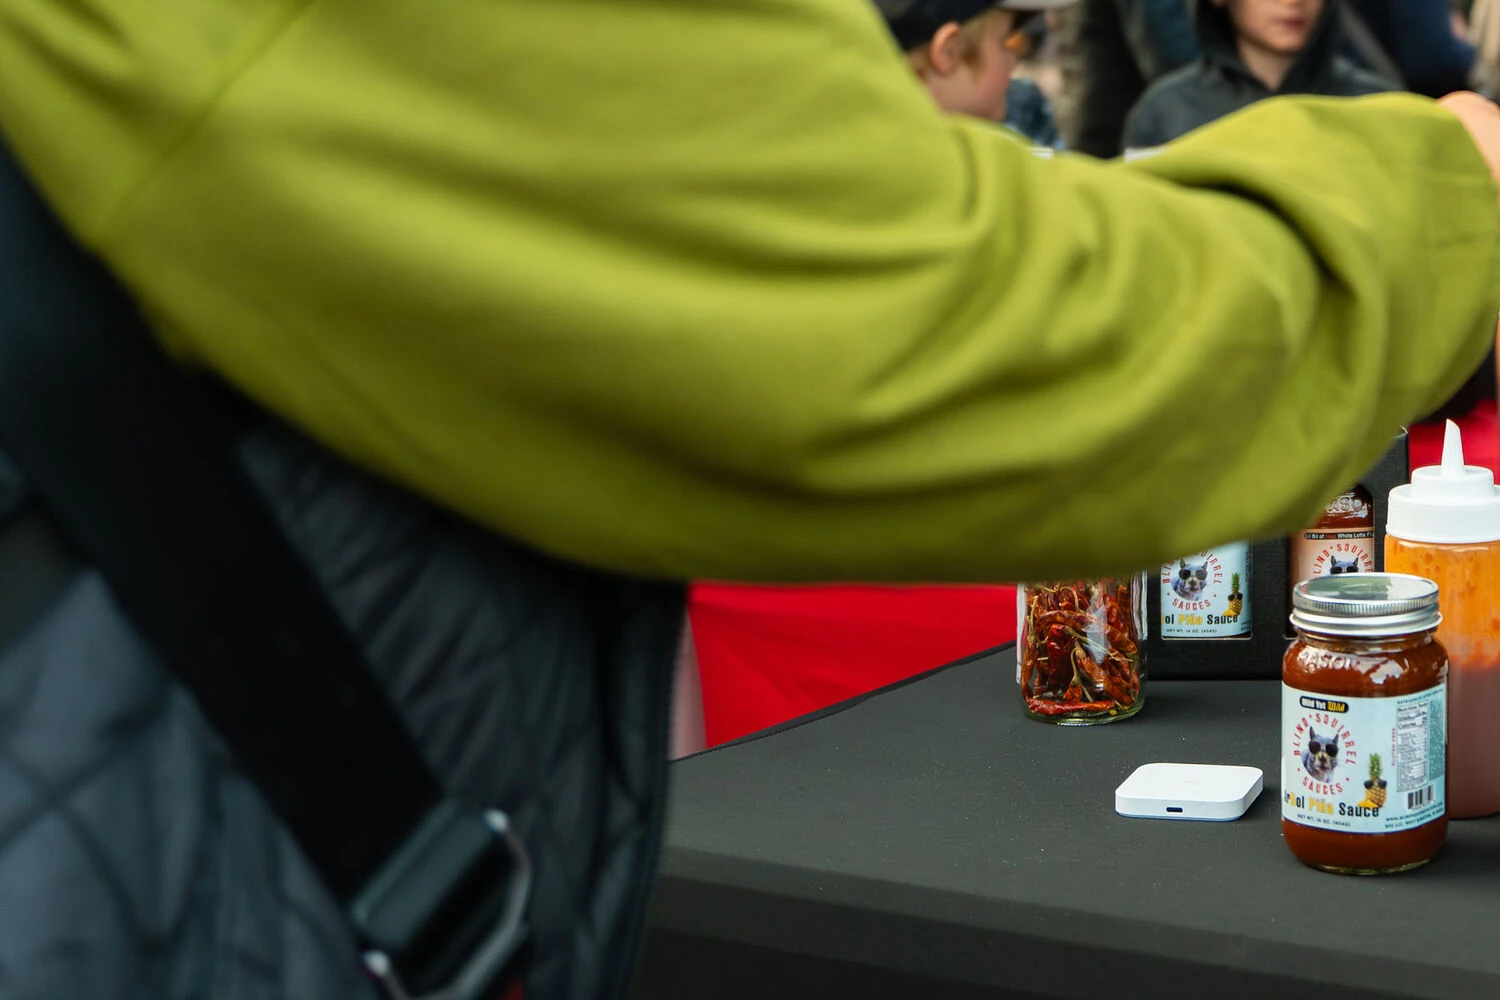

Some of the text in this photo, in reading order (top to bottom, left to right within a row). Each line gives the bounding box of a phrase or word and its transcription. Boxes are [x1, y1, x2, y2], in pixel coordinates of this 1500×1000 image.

[1312, 543, 1373, 575] LIND SQUIRRE
[1161, 559, 1176, 584] BLIN
[1171, 597, 1212, 611] SAUCES
[1206, 613, 1239, 626] Sauce
[1292, 717, 1309, 757] BLIND
[1315, 712, 1358, 765] SQUIRREL
[1302, 776, 1344, 796] SAUCES
[1338, 801, 1380, 818] Sauce
